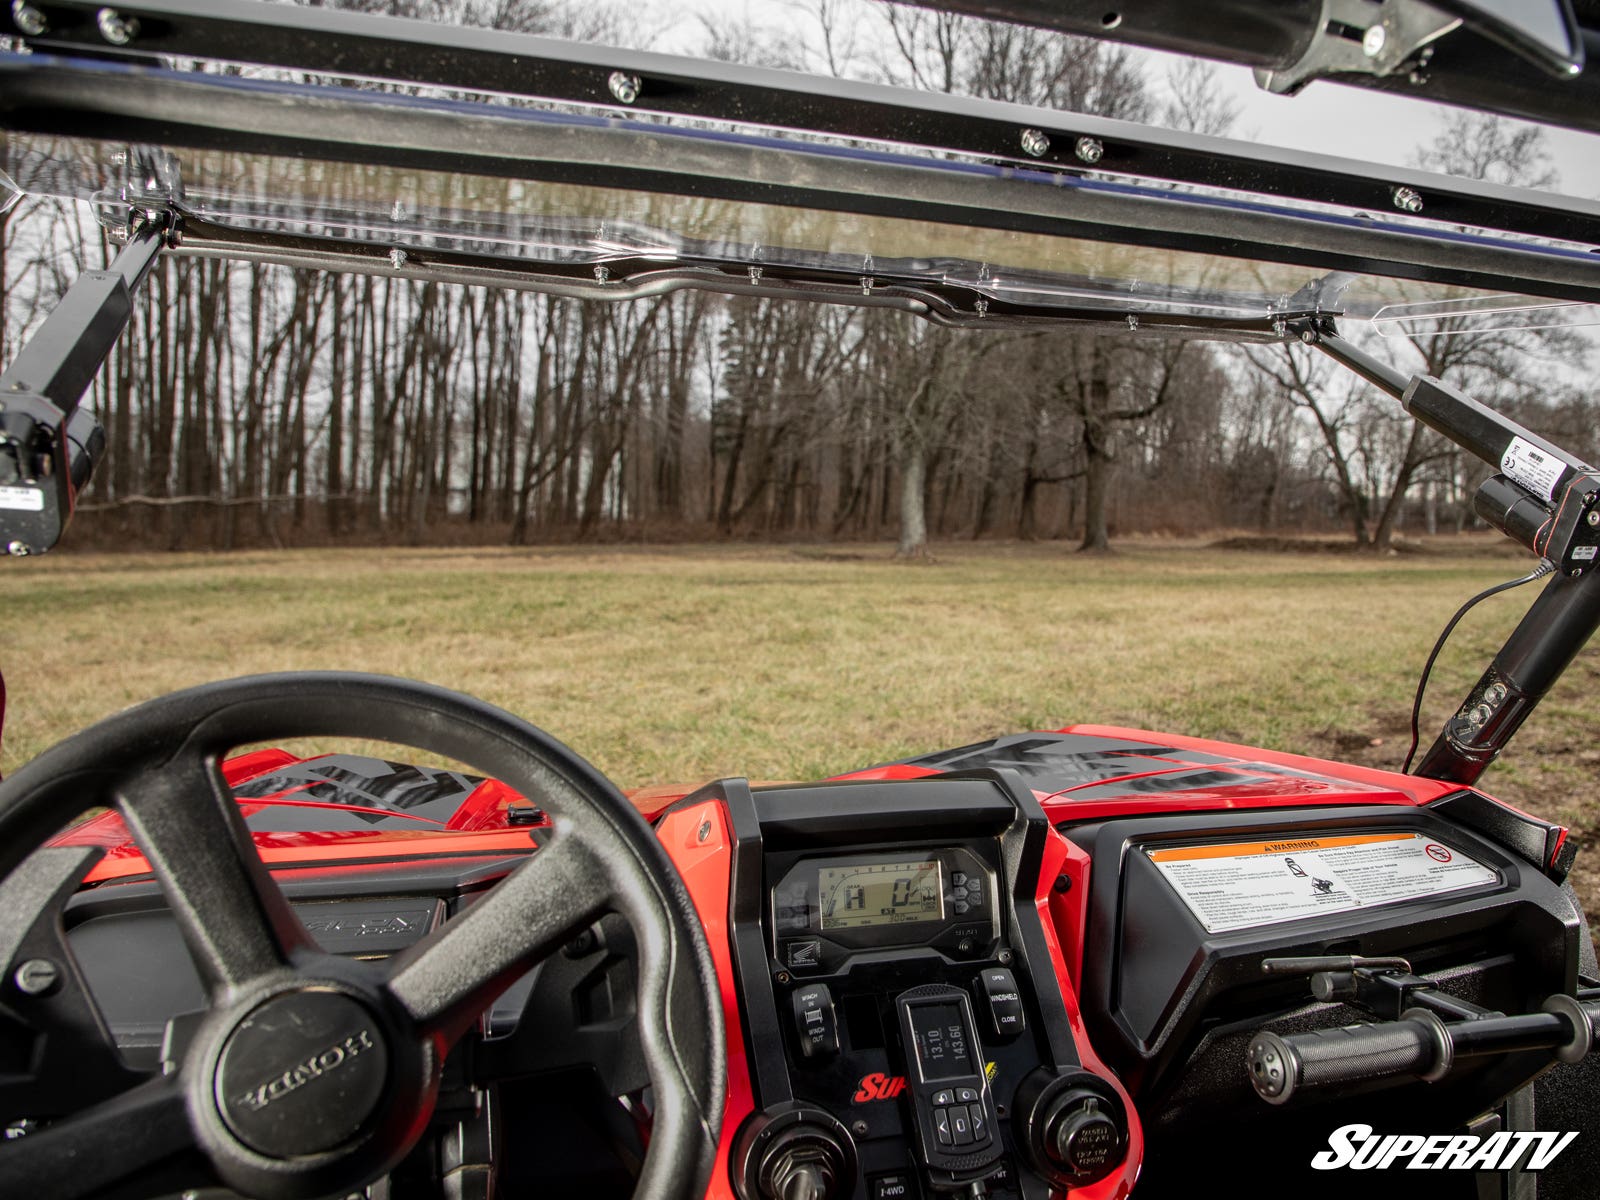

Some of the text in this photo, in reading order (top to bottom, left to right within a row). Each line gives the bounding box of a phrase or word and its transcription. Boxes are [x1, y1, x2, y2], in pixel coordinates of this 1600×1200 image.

[1272, 841, 1319, 851] WARNING
[801, 992, 818, 1001] WINCH
[991, 993, 1018, 1002] WINDSHIELD
[1001, 1015, 1017, 1023] CLOSE
[808, 1026, 825, 1035] WINCH
[812, 1034, 824, 1043] OUT
[948, 1025, 966, 1060] 143.60
[928, 1030, 944, 1060] 13.10
[238, 1030, 375, 1111] HONDA
